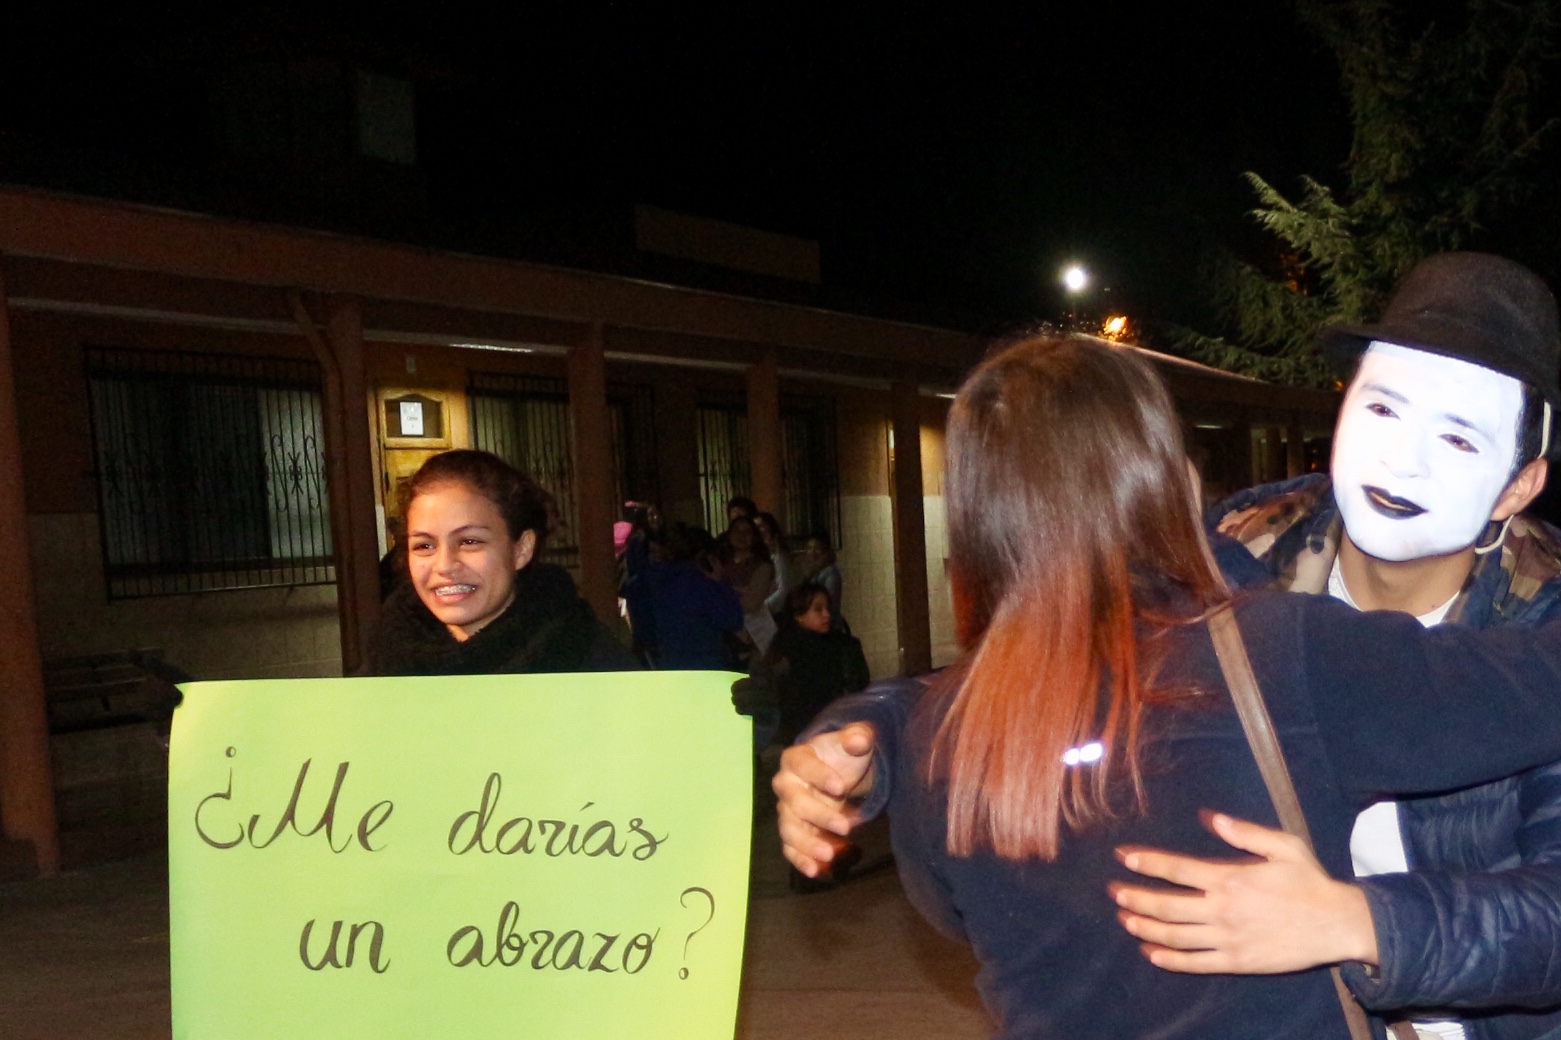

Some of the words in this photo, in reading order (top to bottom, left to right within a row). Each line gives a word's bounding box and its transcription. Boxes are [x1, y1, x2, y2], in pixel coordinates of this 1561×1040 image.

[194, 745, 395, 854] ¿Me
[447, 771, 670, 861] darías
[299, 918, 392, 975] un
[446, 886, 716, 981] abrazo?
